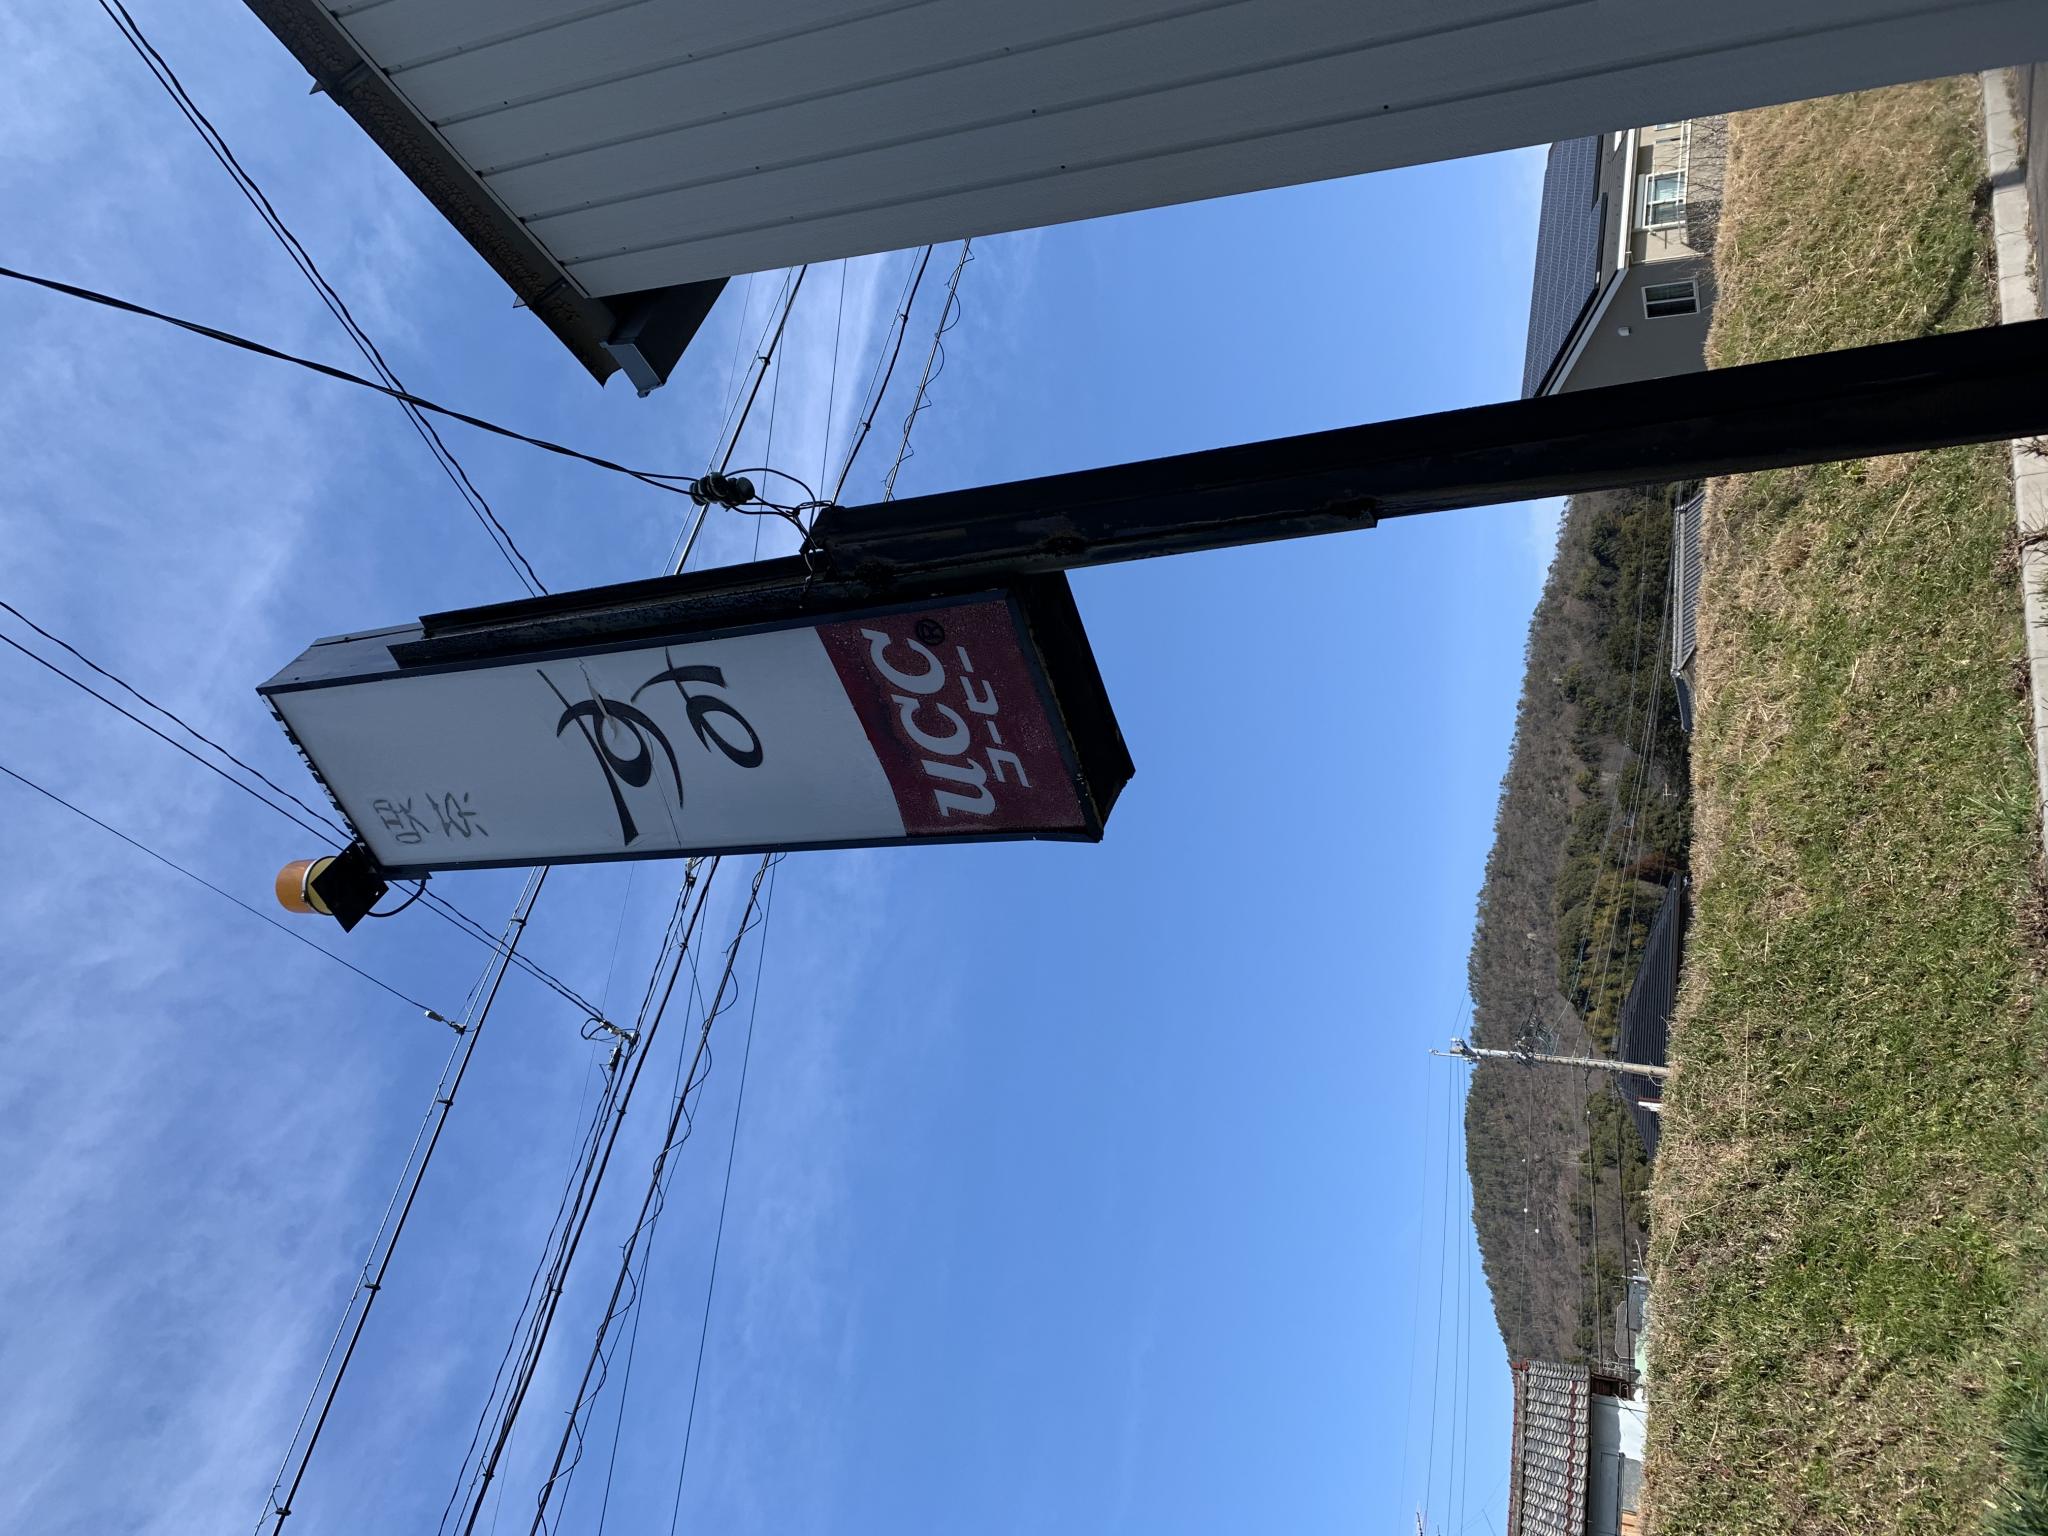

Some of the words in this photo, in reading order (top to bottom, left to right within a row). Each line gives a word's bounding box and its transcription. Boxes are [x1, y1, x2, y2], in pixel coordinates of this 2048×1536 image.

[537, 646, 766, 847] すみ
[957, 646, 1032, 788] コーヒー
[372, 792, 489, 845] 喫茶
